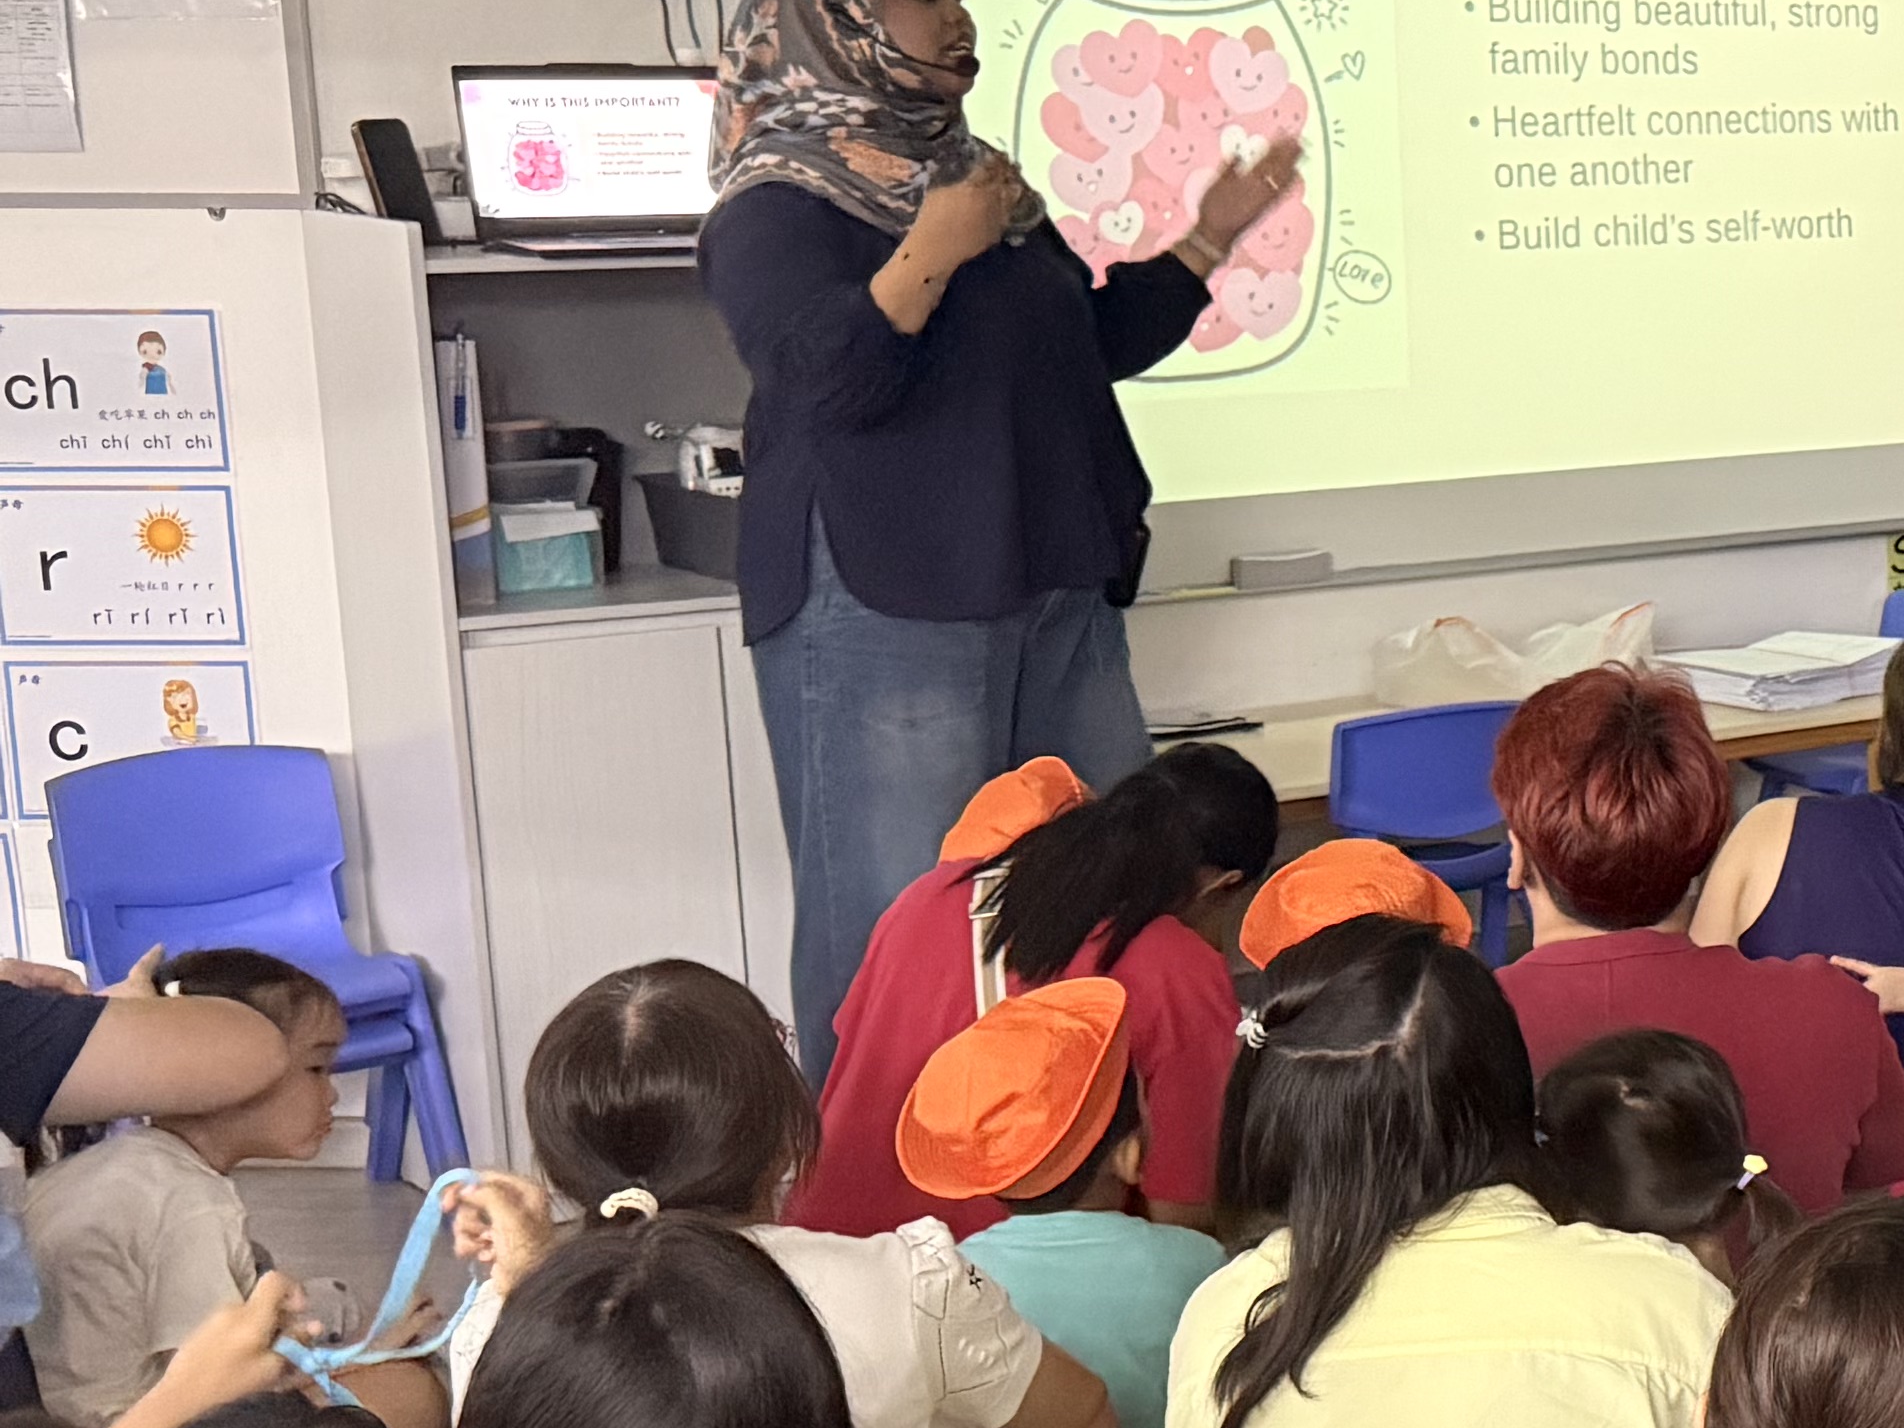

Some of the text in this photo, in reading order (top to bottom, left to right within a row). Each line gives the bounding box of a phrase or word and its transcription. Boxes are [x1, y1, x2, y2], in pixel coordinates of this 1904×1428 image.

[1787, 0, 1879, 36] strong
[1489, 42, 1699, 82] family bonds
[1493, 101, 1900, 138] Heartfelt connections with
[1494, 153, 1694, 188] one another
[1498, 207, 1853, 251] Build child's self-worth
[4, 357, 79, 410] ch
[153, 409, 170, 421] ch
[176, 409, 193, 421] ch
[199, 409, 216, 421] ch
[39, 550, 69, 591] r
[48, 720, 89, 762] c
